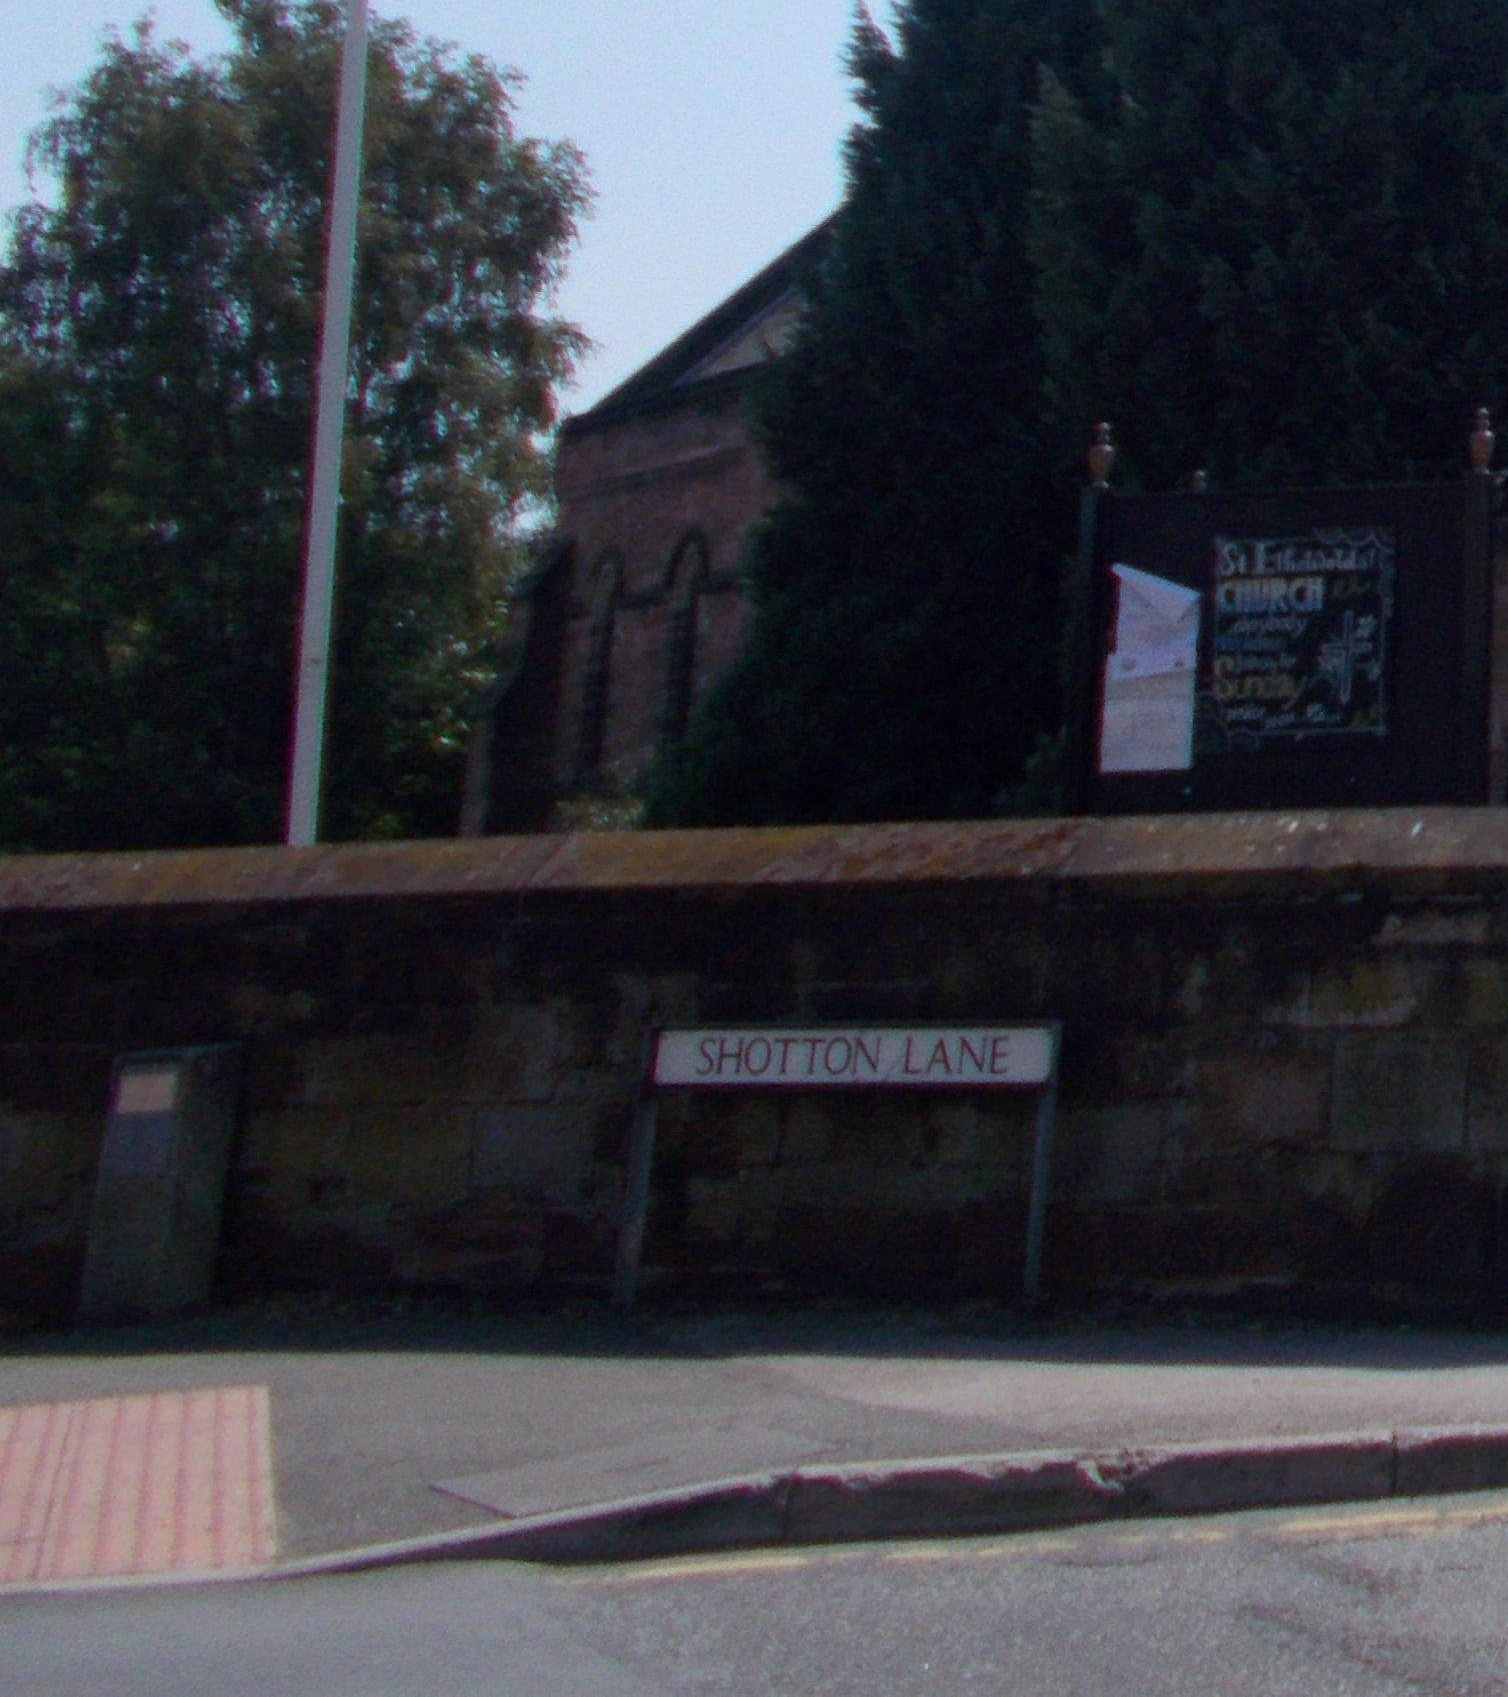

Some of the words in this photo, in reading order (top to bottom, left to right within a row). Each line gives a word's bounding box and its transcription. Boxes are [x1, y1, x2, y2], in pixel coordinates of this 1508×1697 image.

[1216, 577, 1325, 614] CHURCH
[696, 1035, 881, 1076] SHOTTON
[903, 1034, 1010, 1075] LANE
